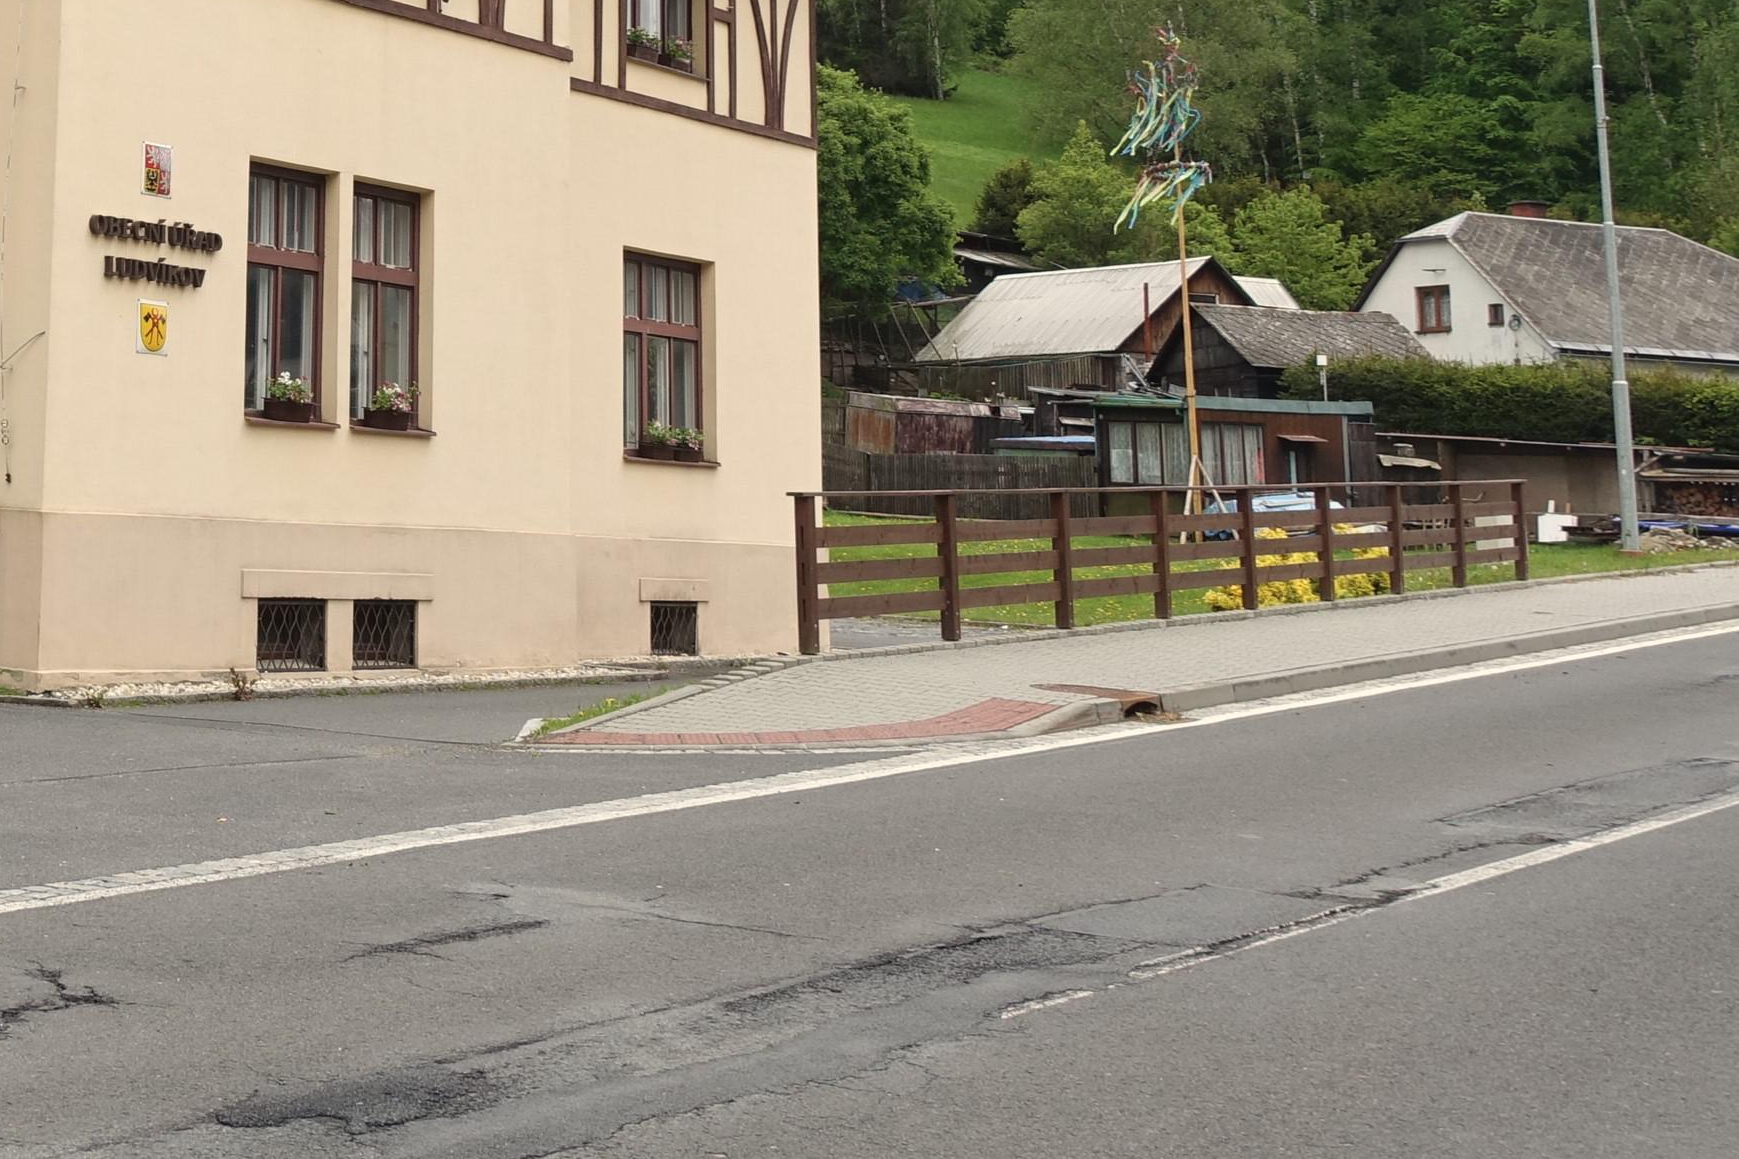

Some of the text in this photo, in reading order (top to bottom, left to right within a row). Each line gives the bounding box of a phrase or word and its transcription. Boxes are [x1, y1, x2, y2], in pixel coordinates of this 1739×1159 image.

[89, 214, 223, 252] OBECNÍ ÚŘAD
[104, 255, 207, 288] LUDVÍKOV
